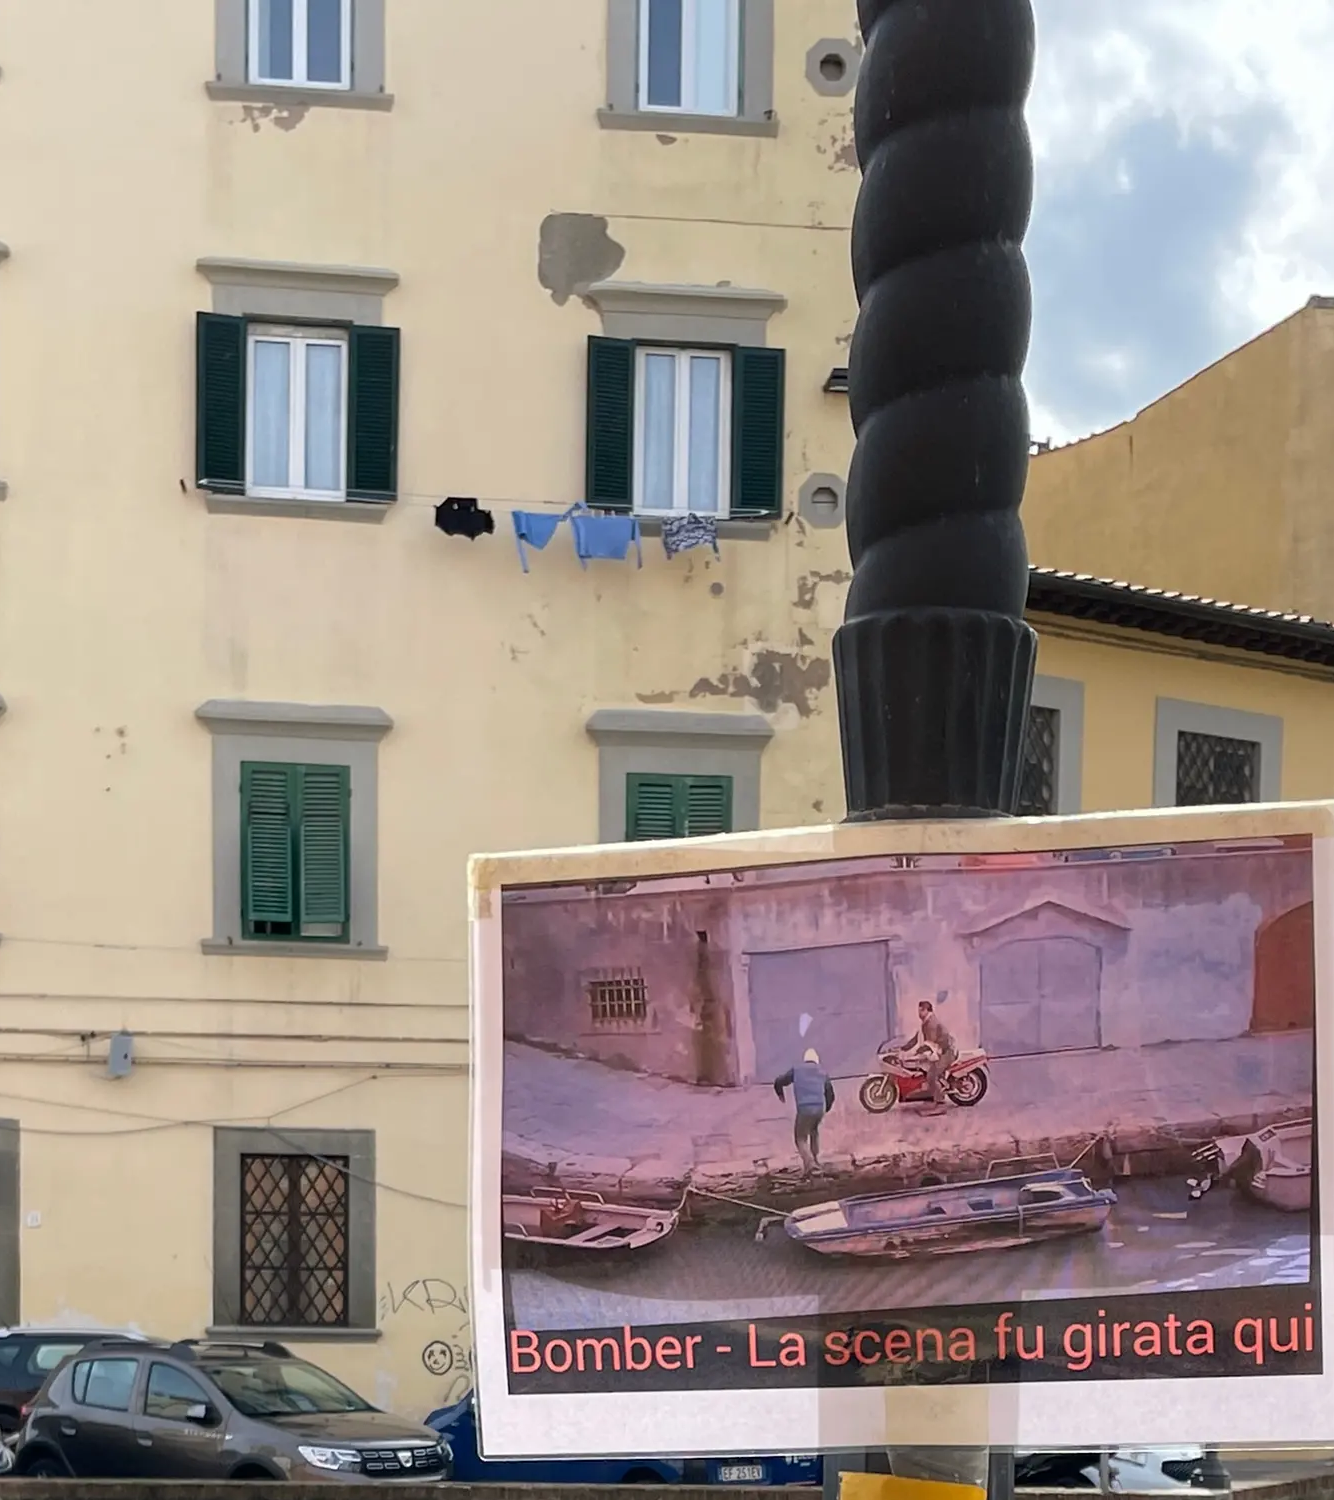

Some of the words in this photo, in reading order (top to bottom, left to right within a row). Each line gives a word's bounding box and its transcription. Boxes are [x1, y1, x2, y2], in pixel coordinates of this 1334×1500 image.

[510, 1327, 702, 1373] Bomber
[749, 1325, 806, 1368] La
[825, 1328, 976, 1365] scena
[994, 1313, 1044, 1360] fu
[1063, 1311, 1215, 1371] girata
[1234, 1306, 1314, 1365] qui
